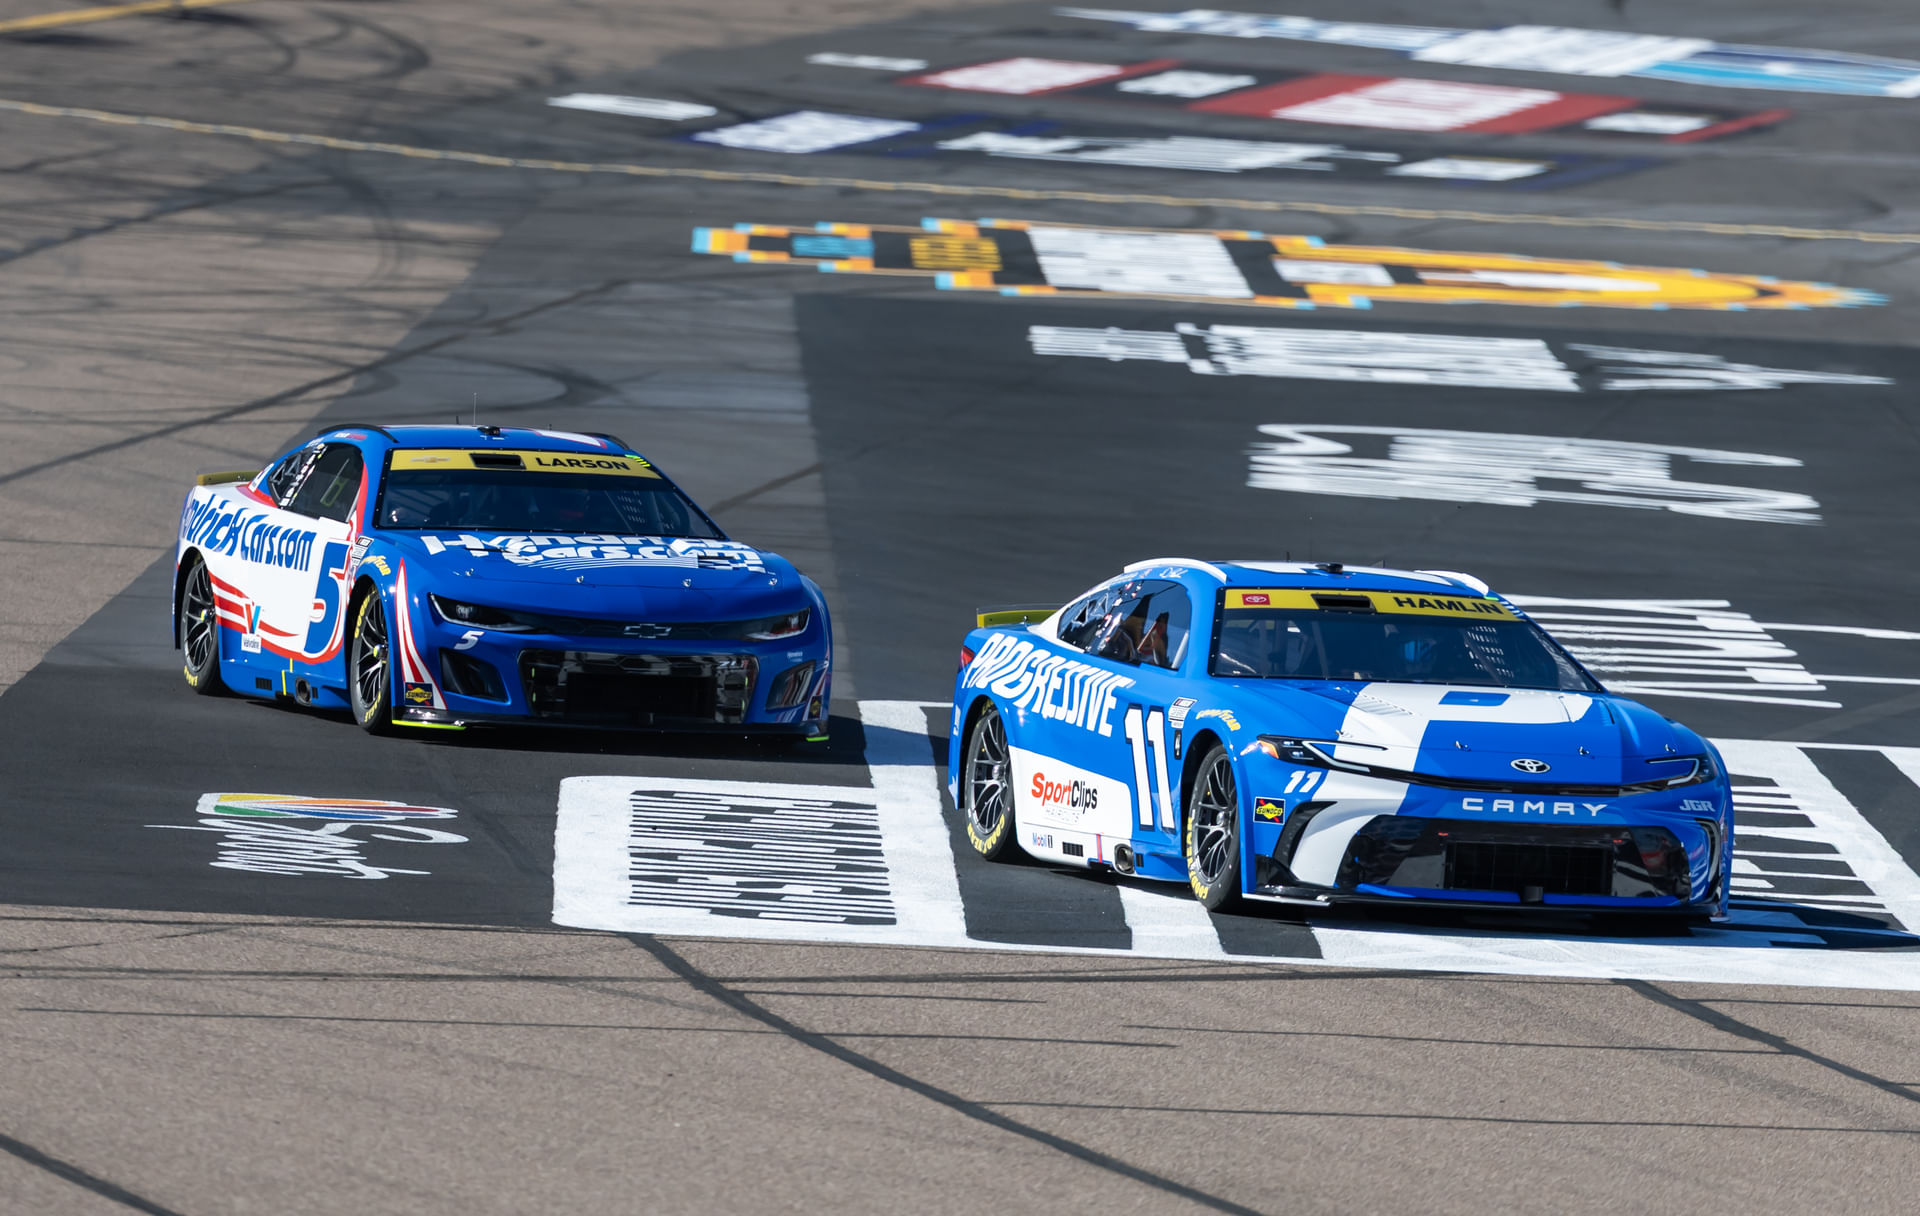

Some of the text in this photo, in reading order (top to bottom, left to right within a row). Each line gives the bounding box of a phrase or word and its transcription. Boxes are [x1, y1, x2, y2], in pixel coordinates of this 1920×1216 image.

[535, 457, 631, 471] LARSON
[304, 540, 352, 657] 5
[1393, 596, 1505, 615] HAMLIN
[453, 630, 485, 650] 5
[961, 632, 1136, 737] PROGRESSIVE
[406, 690, 432, 700] SUNOCO
[1123, 703, 1177, 834] 11
[1283, 770, 1322, 795] 11
[1257, 807, 1283, 816] SUNOCO
[1462, 797, 1607, 817] CAMRY
[1679, 799, 1716, 813] JGR
[967, 813, 1005, 854] GOODYEAR
[1032, 832, 1047, 847] Mobil
